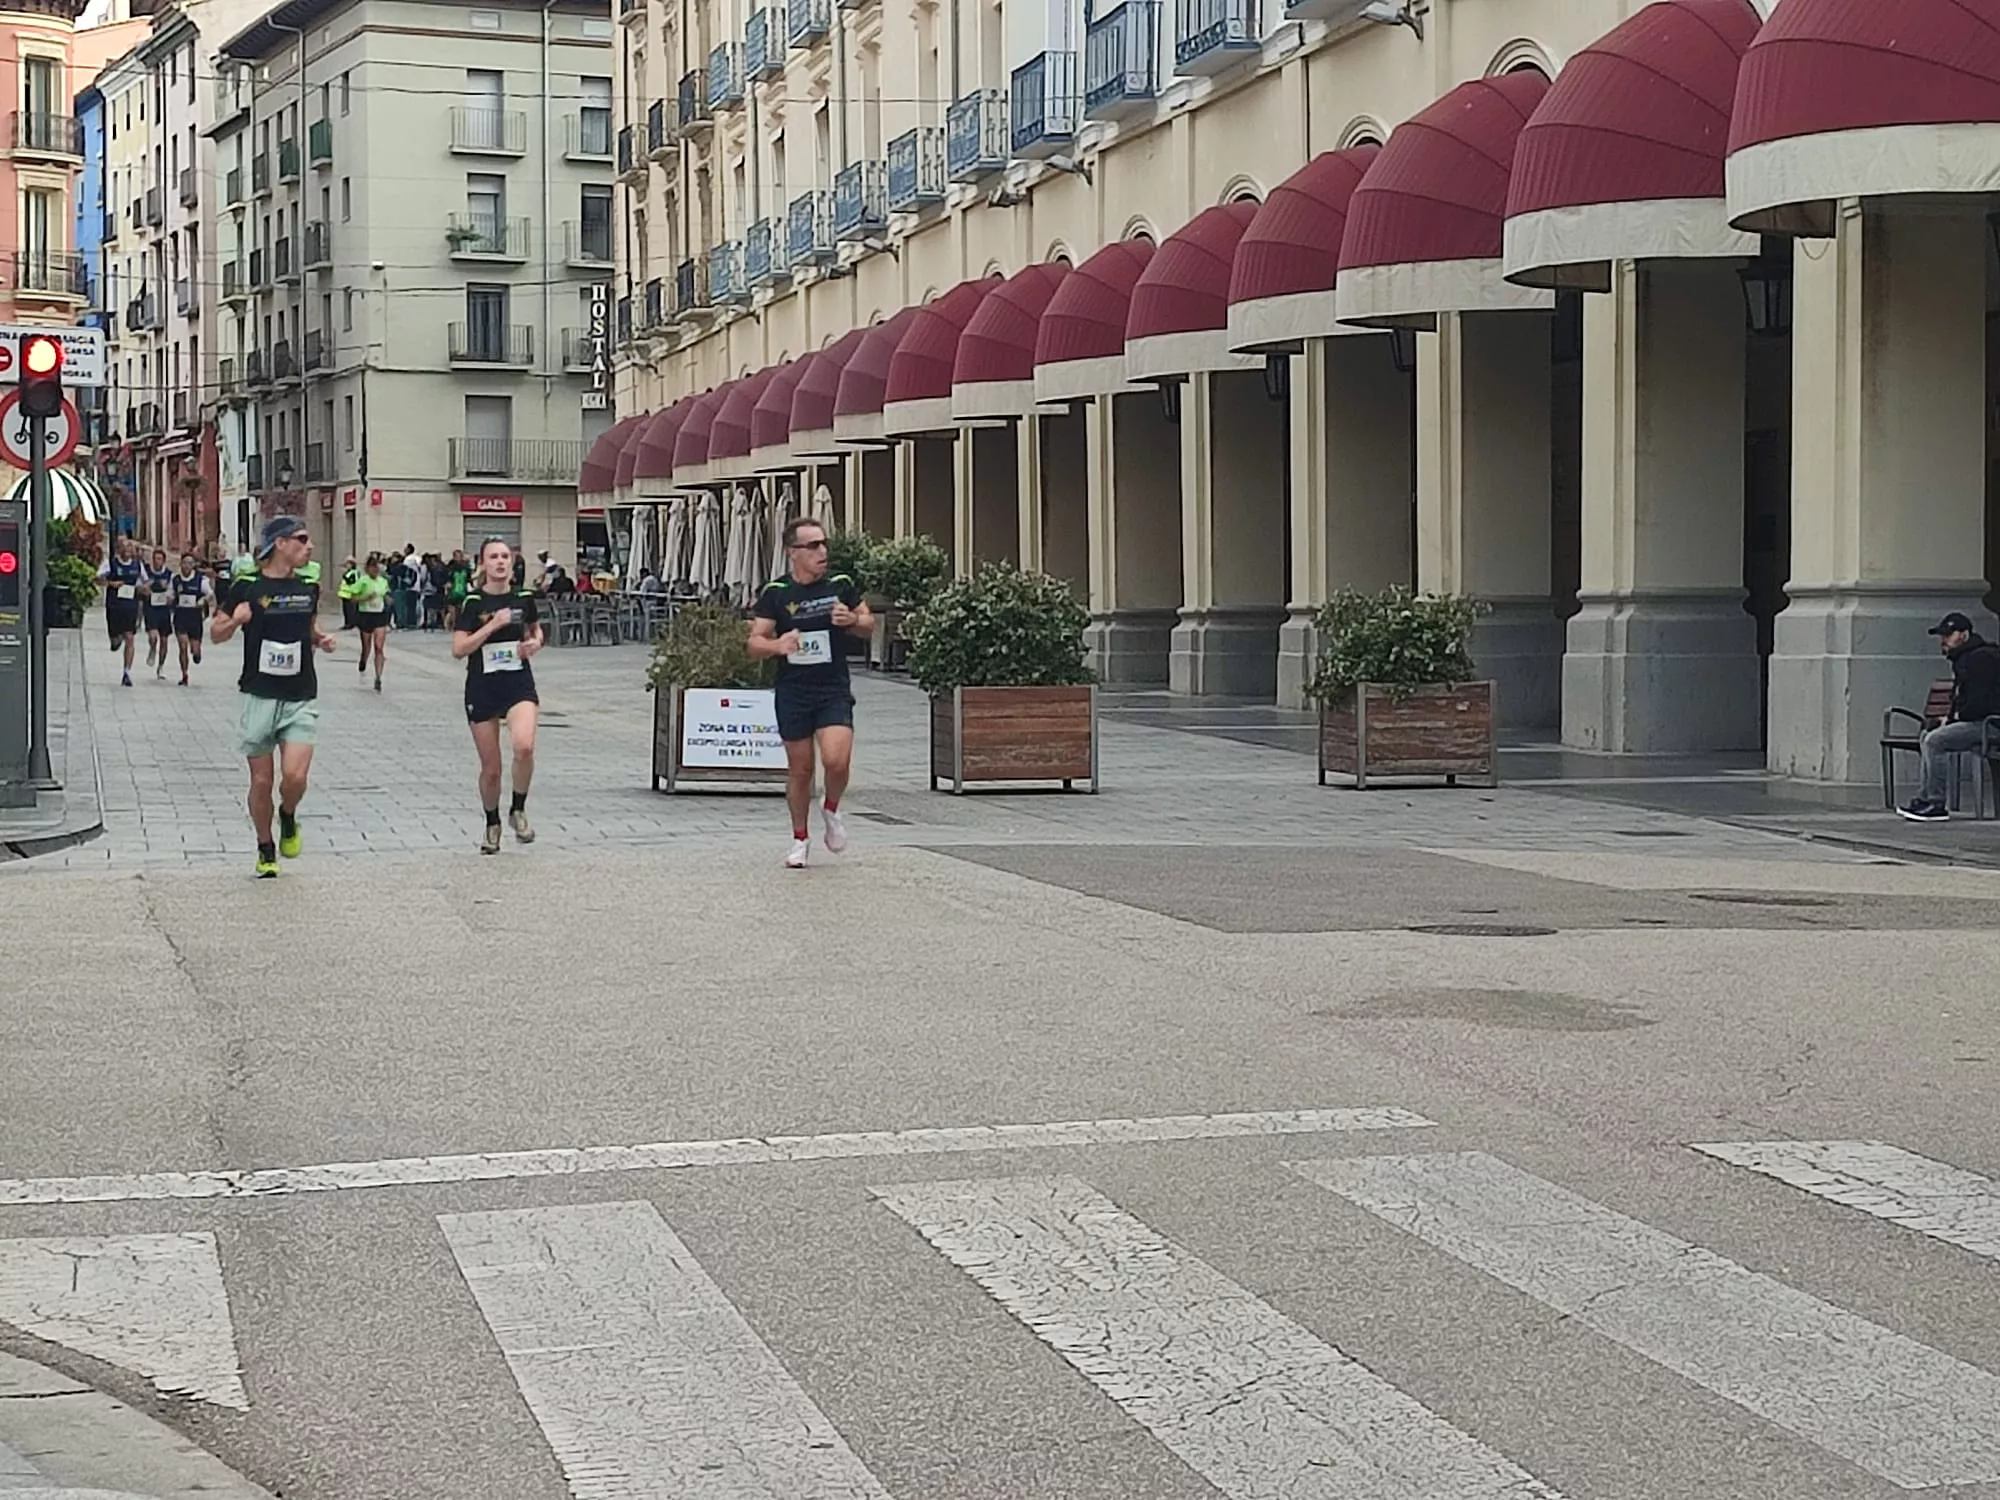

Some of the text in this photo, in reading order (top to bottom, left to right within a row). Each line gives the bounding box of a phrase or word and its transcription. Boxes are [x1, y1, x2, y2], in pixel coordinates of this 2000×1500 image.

[591, 284, 607, 389] HOSTAL
[698, 723, 725, 733] ZONA
[727, 724, 738, 733] DE
